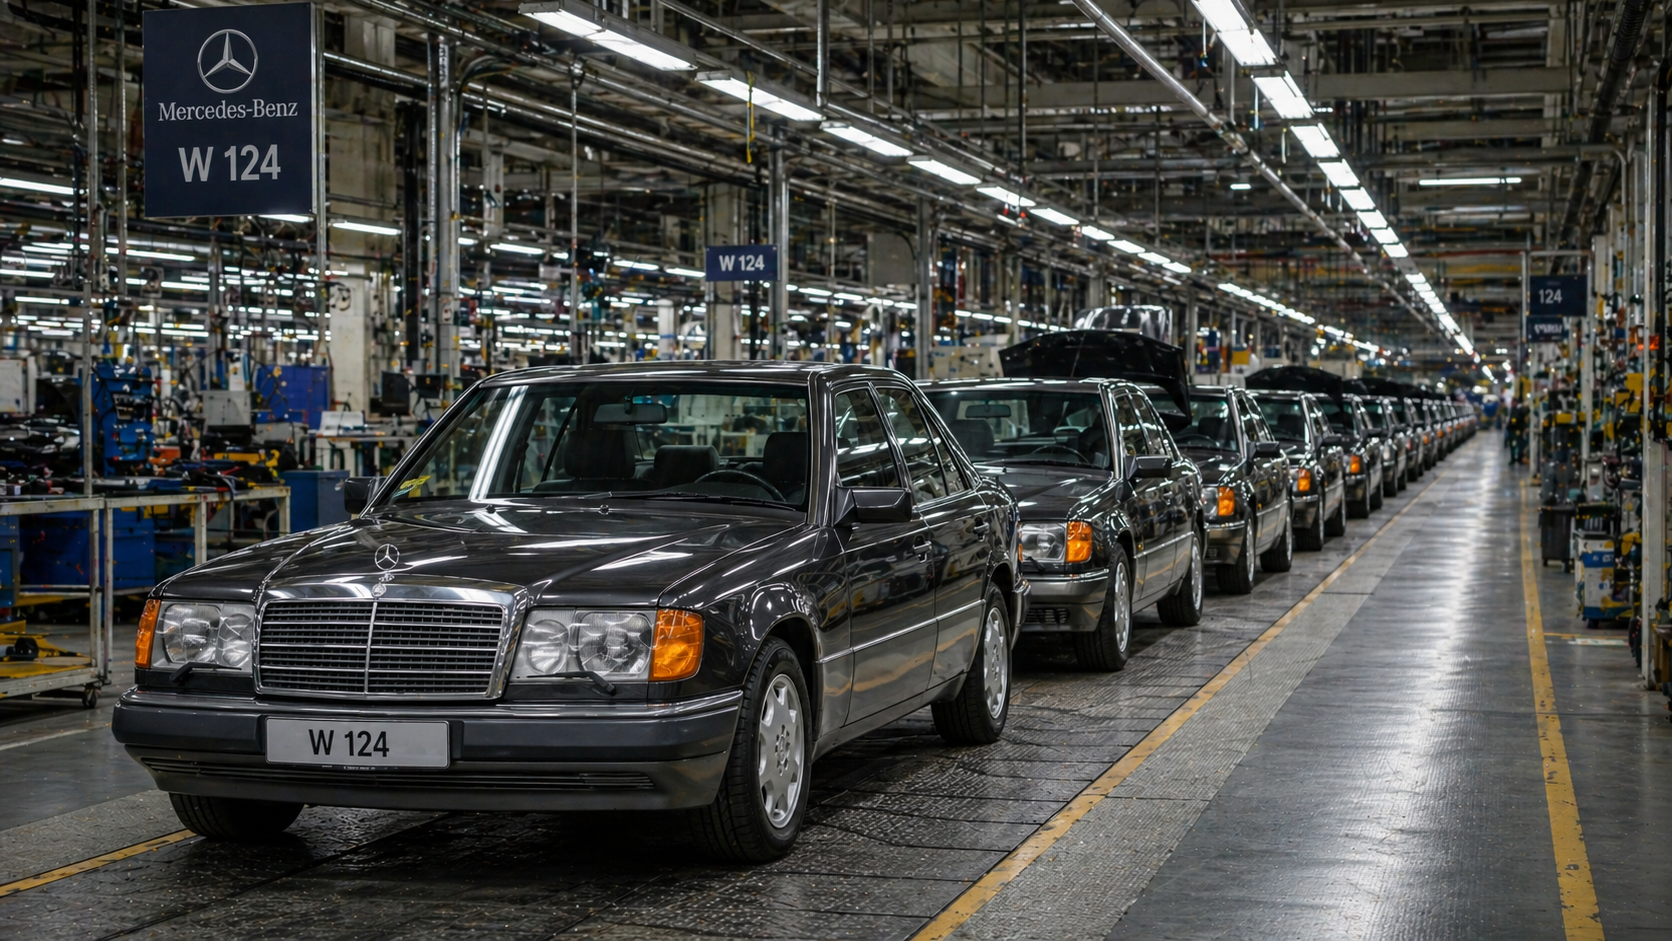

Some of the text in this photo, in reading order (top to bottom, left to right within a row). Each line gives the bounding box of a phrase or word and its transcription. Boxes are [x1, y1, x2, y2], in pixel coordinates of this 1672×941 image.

[158, 98, 298, 121] Mercedes-Benz
[178, 144, 281, 182] W 124
[718, 254, 765, 272] W 124
[1538, 288, 1562, 304] 124
[308, 729, 389, 758] W 124
